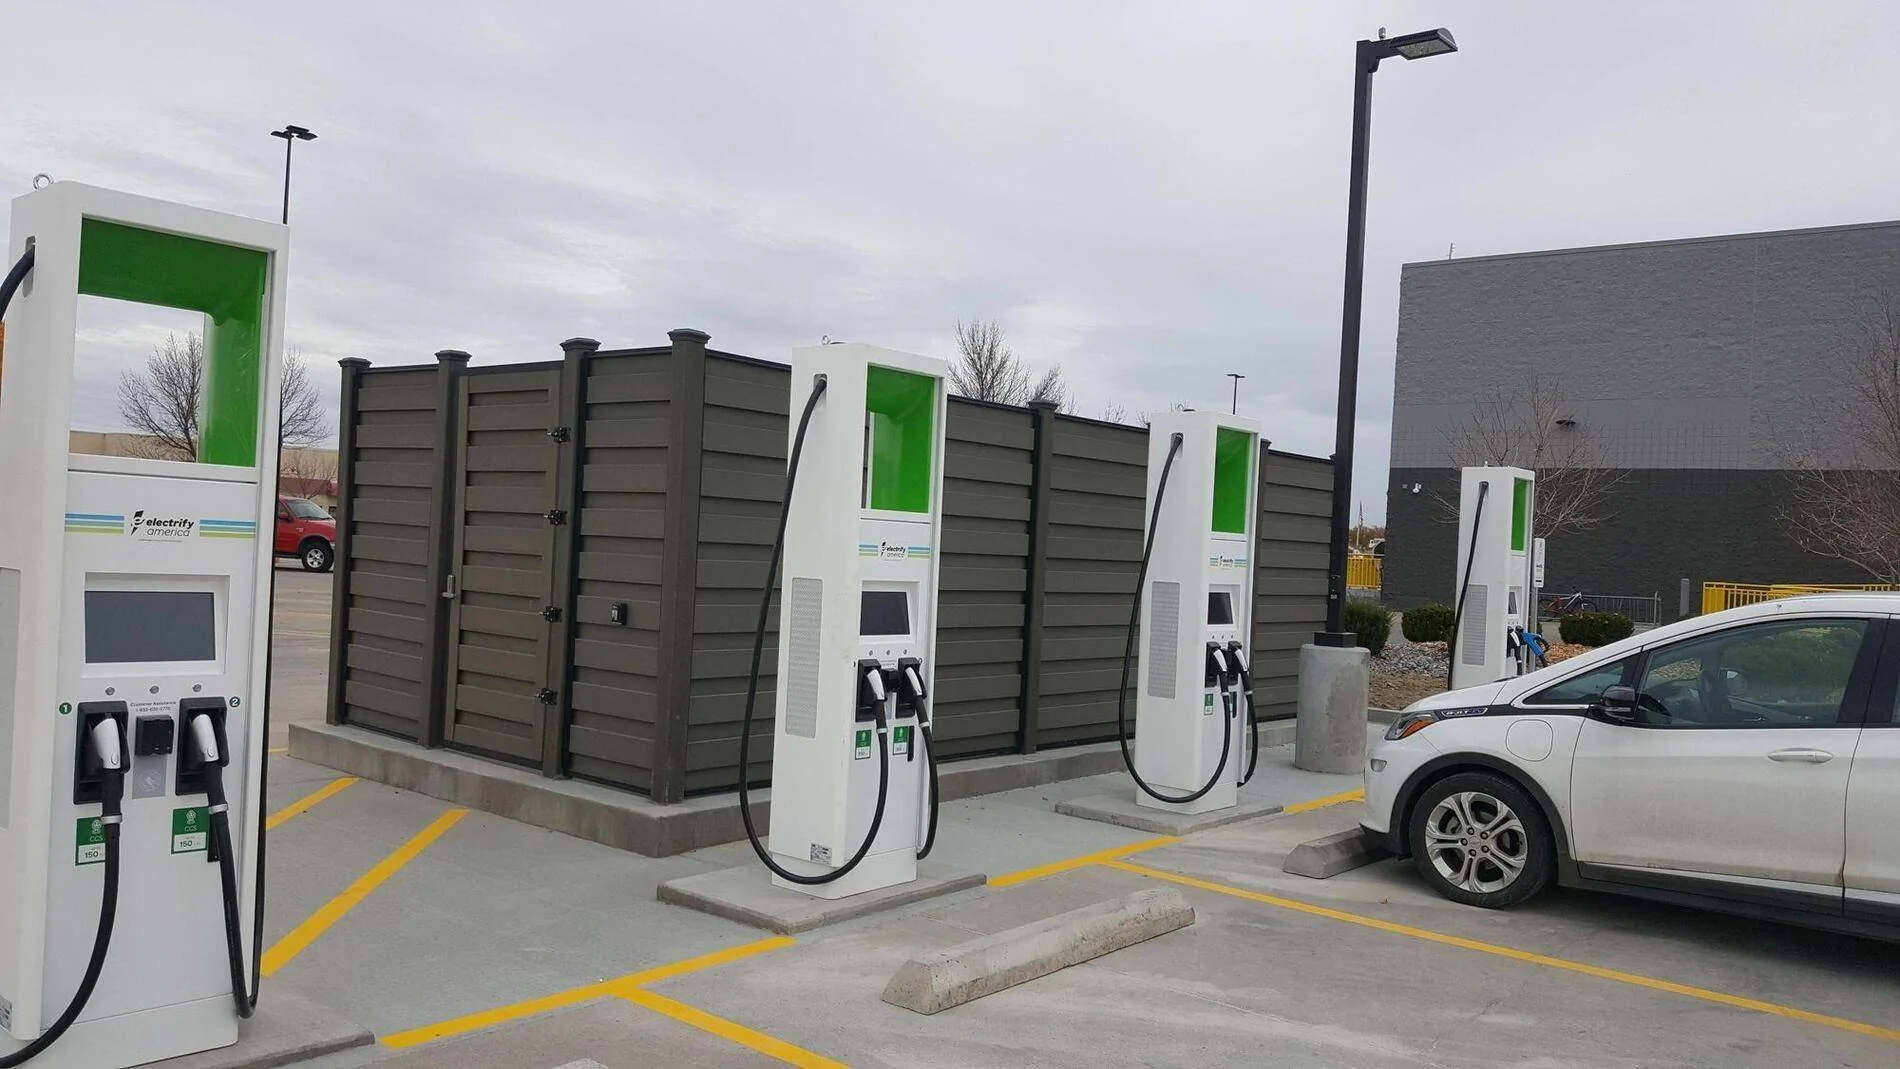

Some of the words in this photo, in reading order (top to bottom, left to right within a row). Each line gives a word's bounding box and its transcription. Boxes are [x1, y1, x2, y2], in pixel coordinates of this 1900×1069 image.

[146, 518, 194, 529] electrify
[147, 528, 190, 537] america
[180, 840, 193, 848] 150
[85, 850, 98, 859] 150
